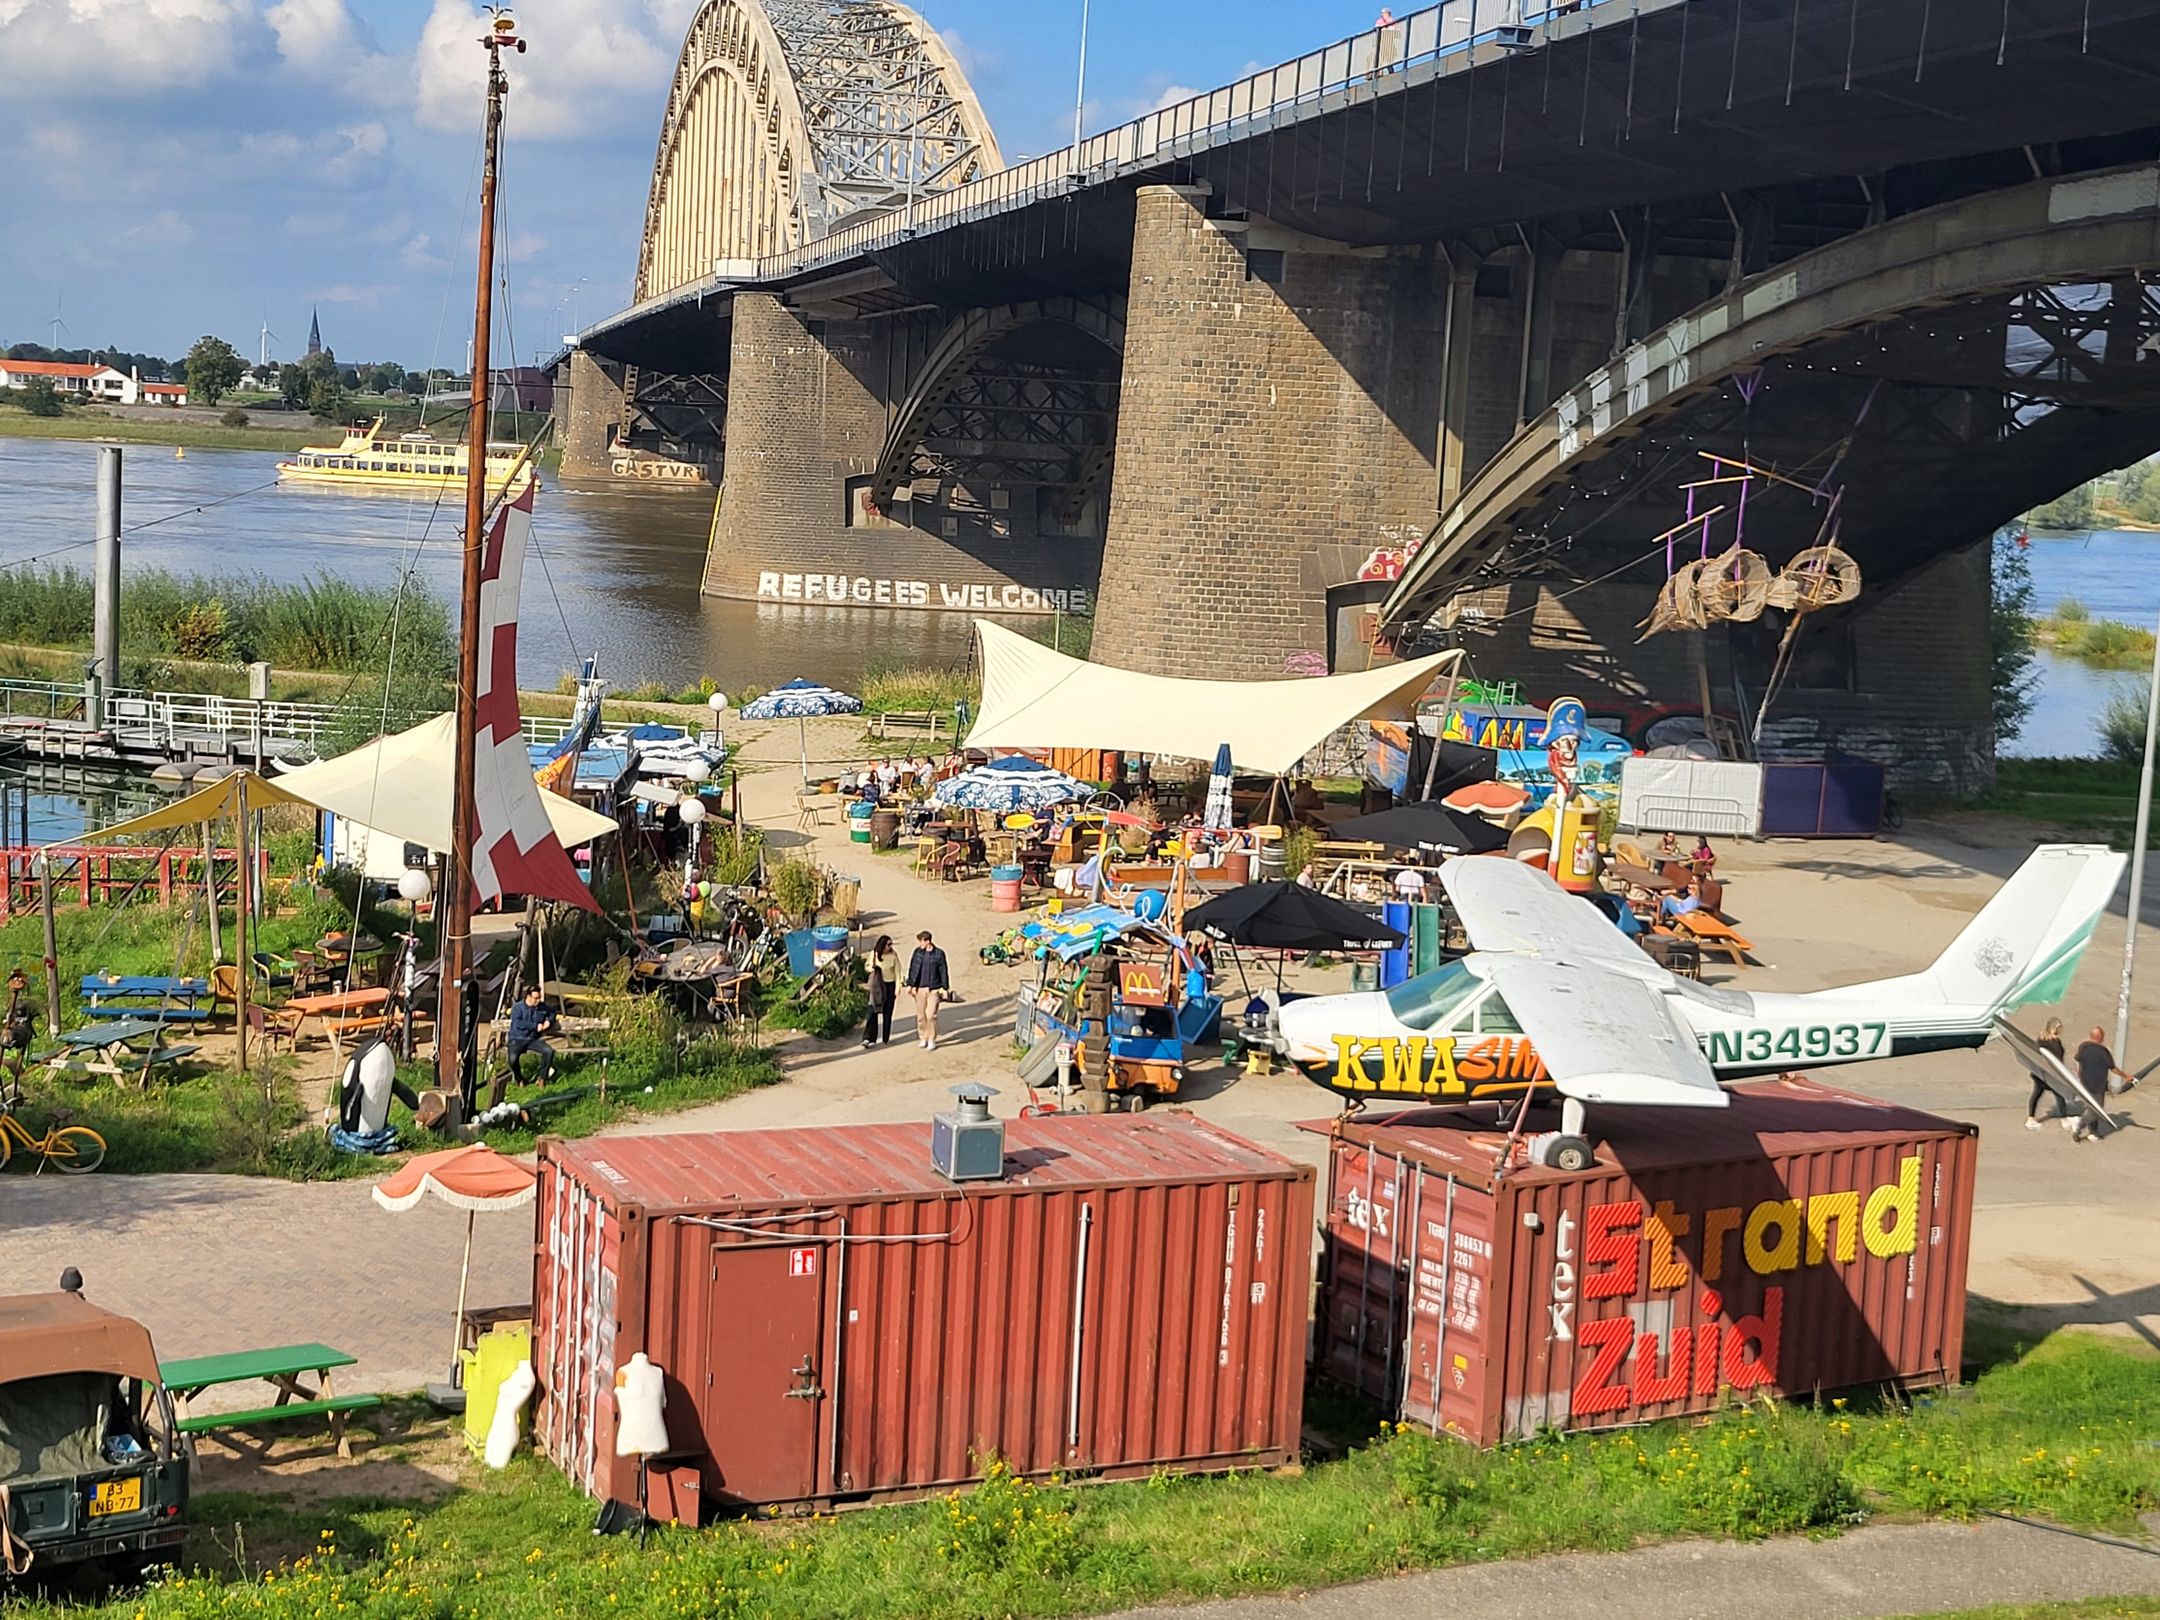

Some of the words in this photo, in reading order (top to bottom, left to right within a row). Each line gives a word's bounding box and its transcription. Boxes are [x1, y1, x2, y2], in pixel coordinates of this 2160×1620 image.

[757, 570, 930, 606] REFUGEES
[939, 582, 1086, 611] WELCOME
[1709, 1021, 1887, 1063] N34937
[1545, 1208, 1576, 1341] tex
[1582, 1155, 1922, 1301] Strand
[1571, 1286, 1784, 1416] Zuid
